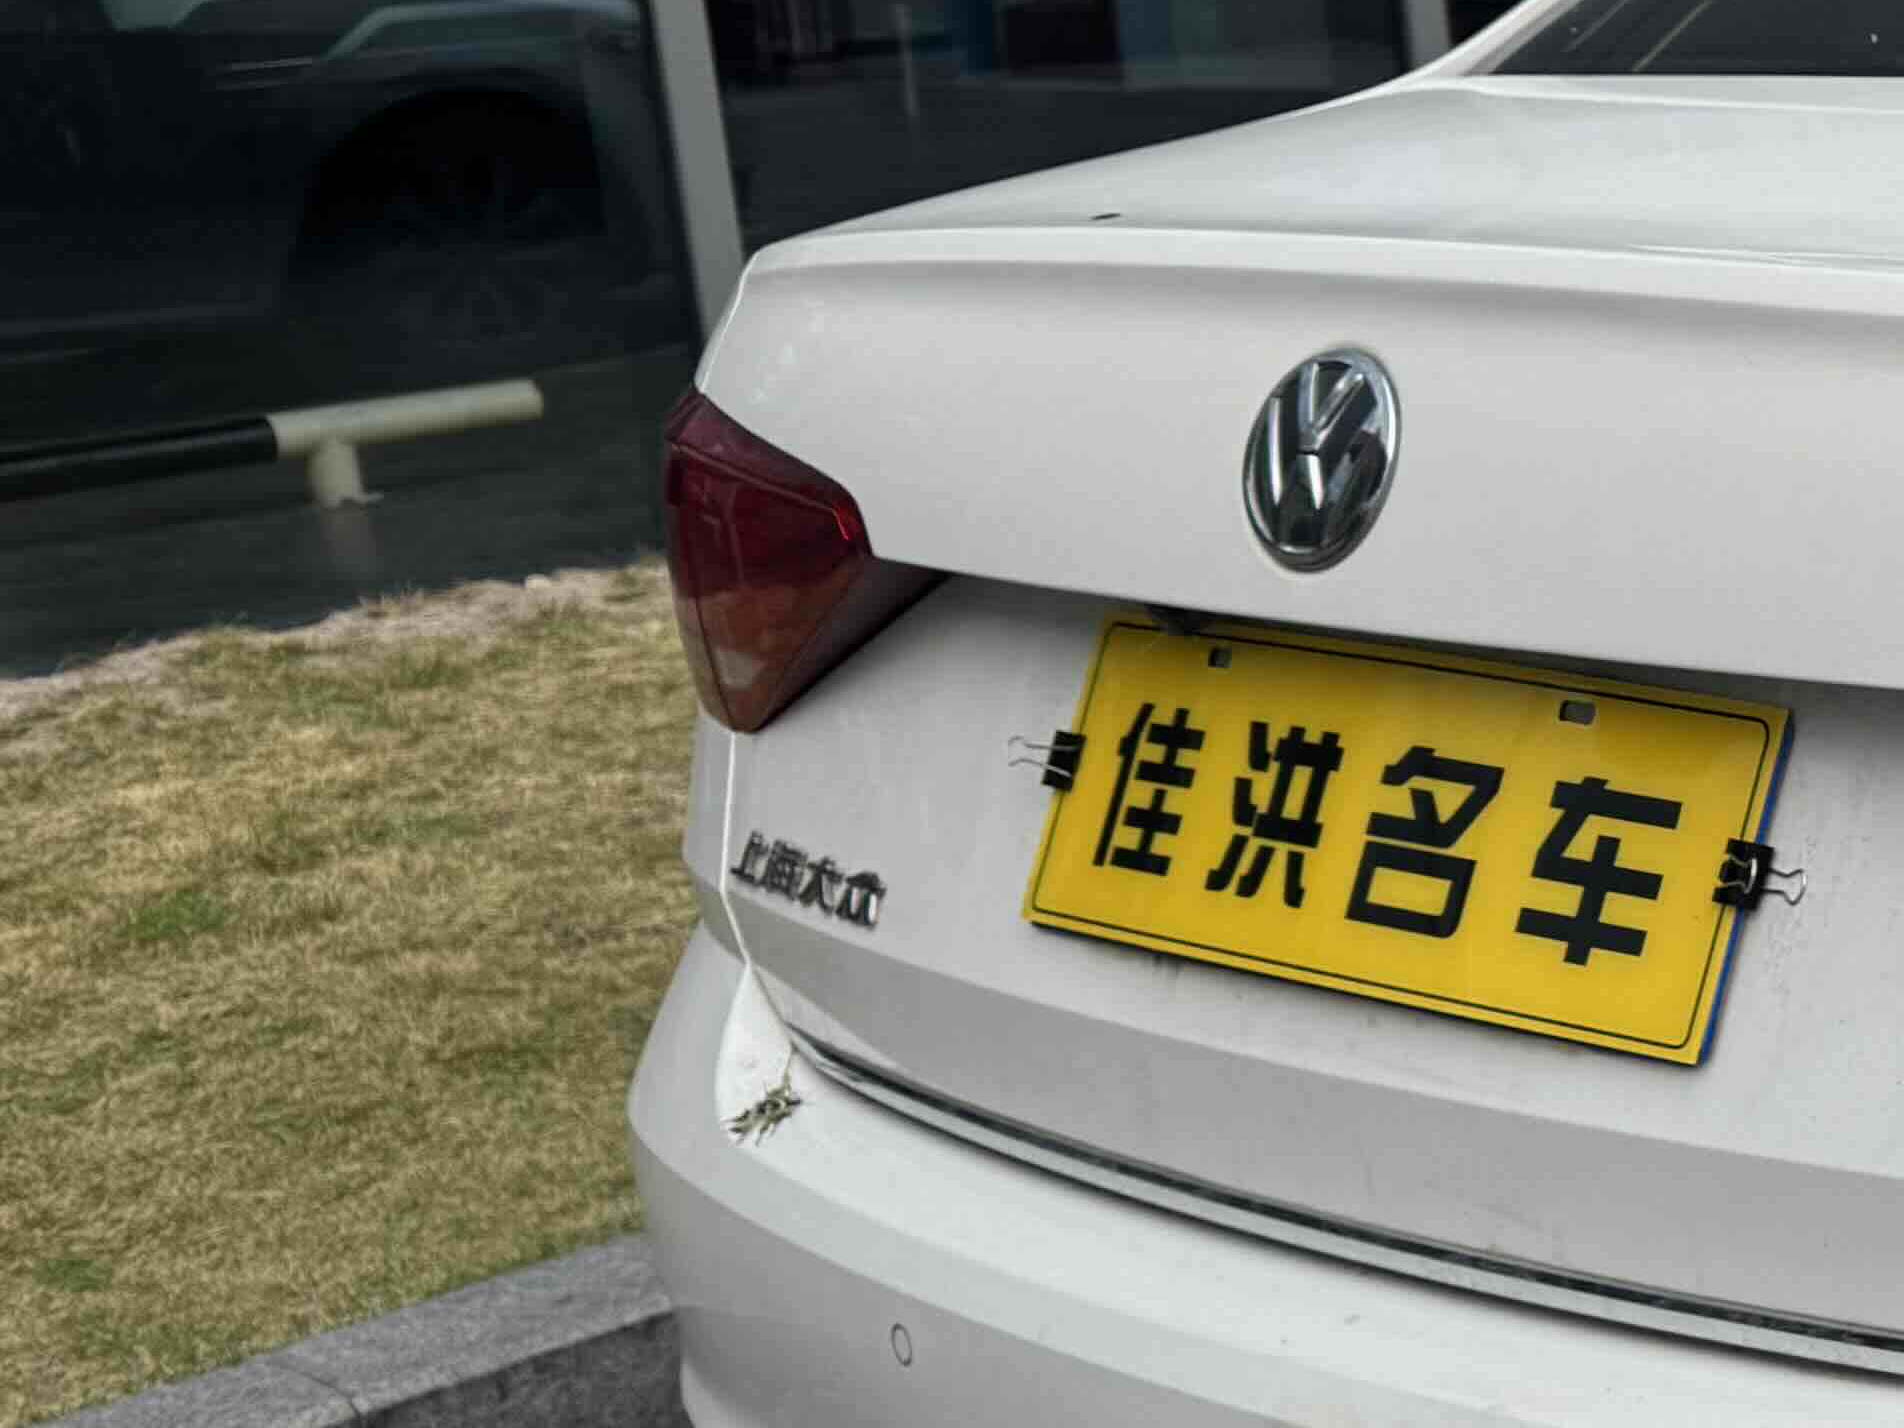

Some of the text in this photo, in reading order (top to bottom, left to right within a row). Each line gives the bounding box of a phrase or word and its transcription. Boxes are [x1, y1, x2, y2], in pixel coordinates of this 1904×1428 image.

[730, 829, 888, 932] 上海大众
[1092, 700, 1684, 967] 佳洪名车
